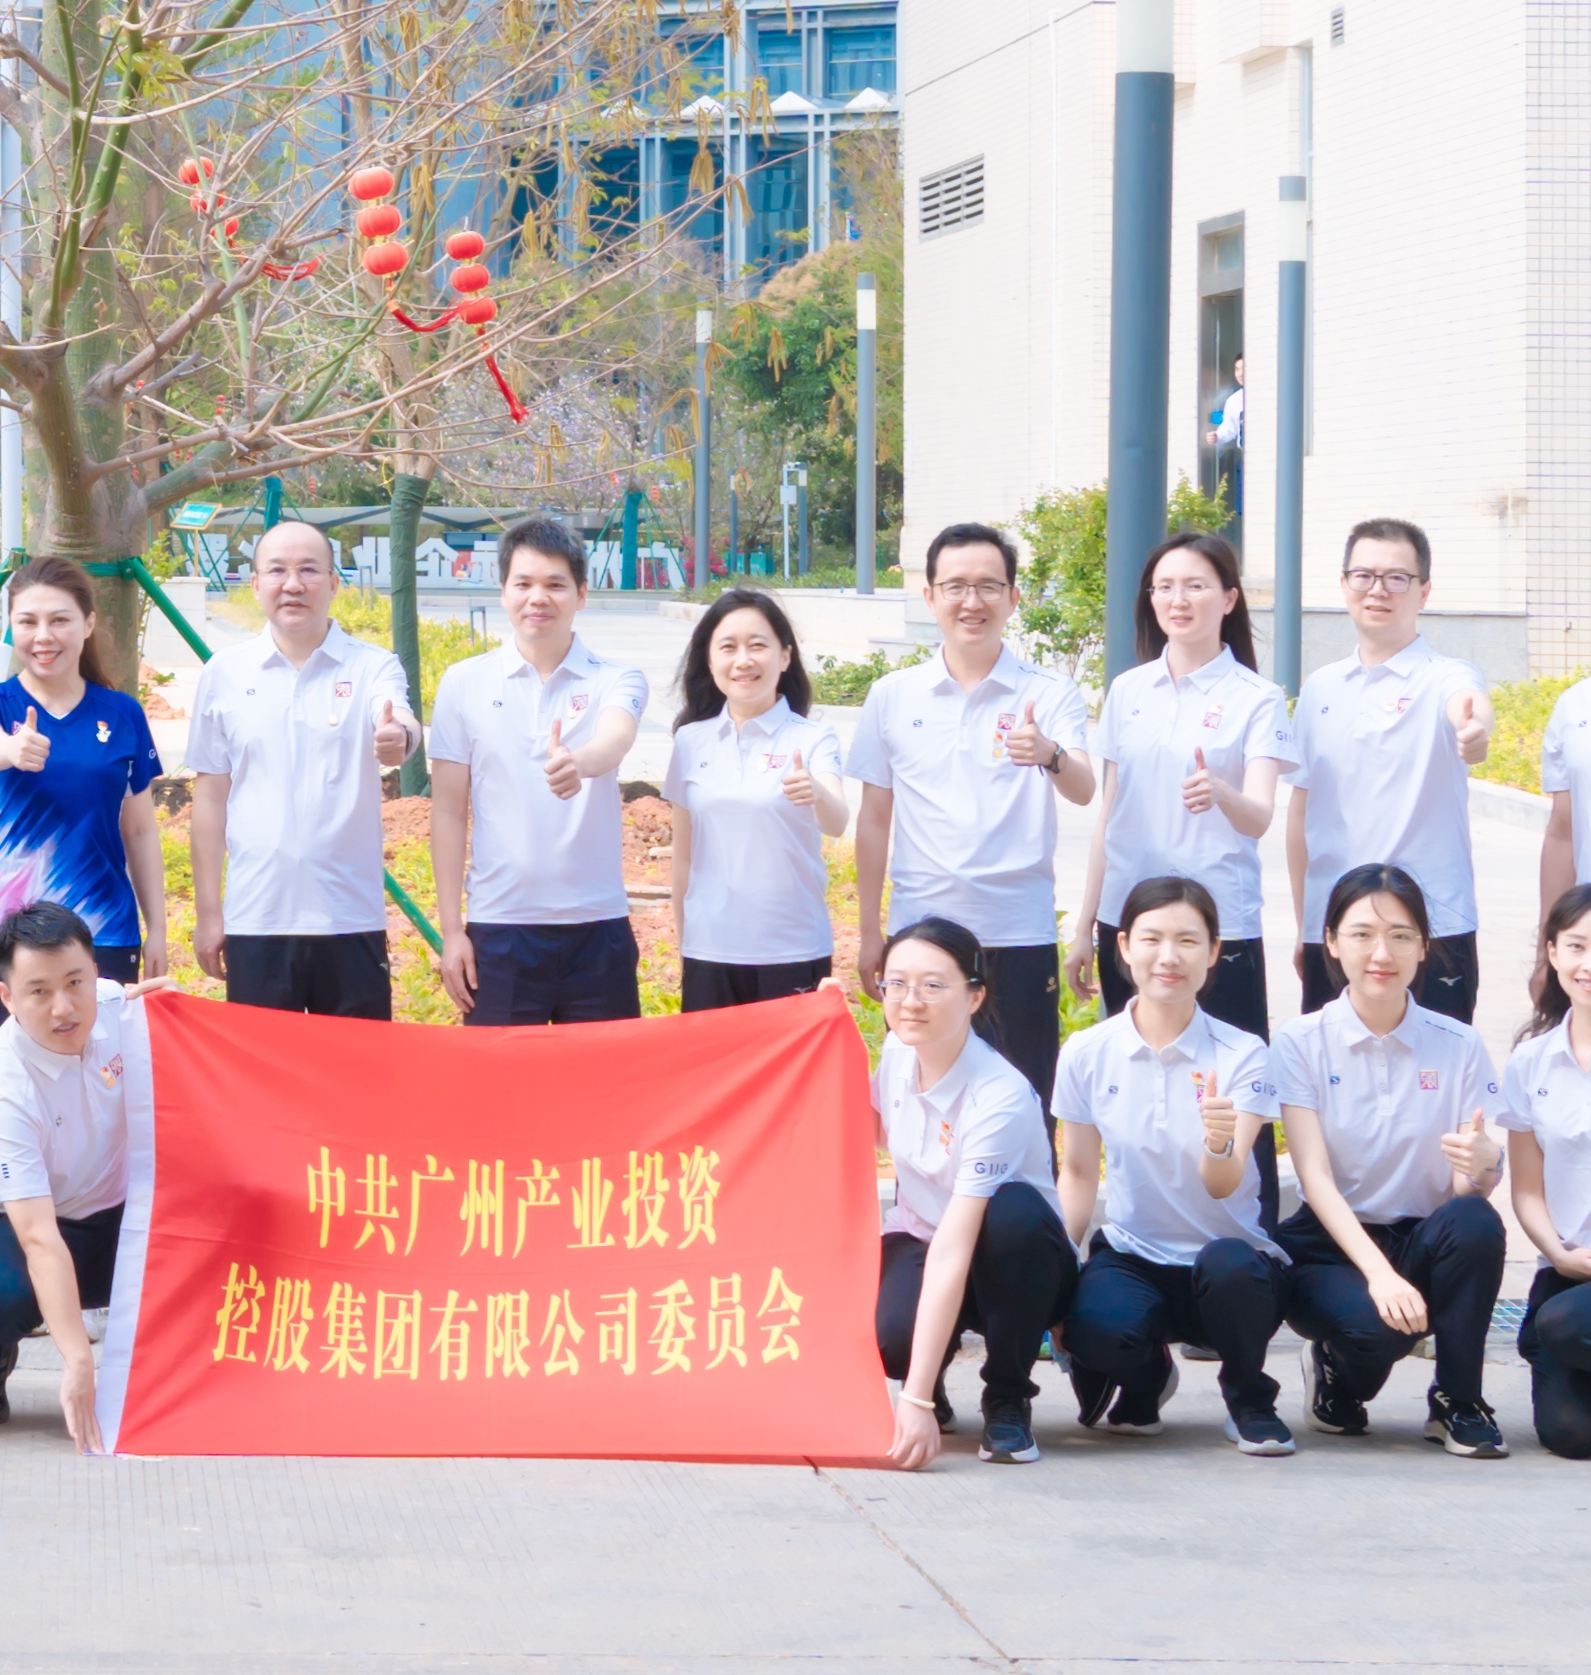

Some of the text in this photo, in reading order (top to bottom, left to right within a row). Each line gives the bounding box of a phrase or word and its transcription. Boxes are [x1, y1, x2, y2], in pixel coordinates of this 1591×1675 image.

[307, 1145, 722, 1258] 中共广州产业投资
[212, 1260, 804, 1382] 控股集团有限公司委员会
